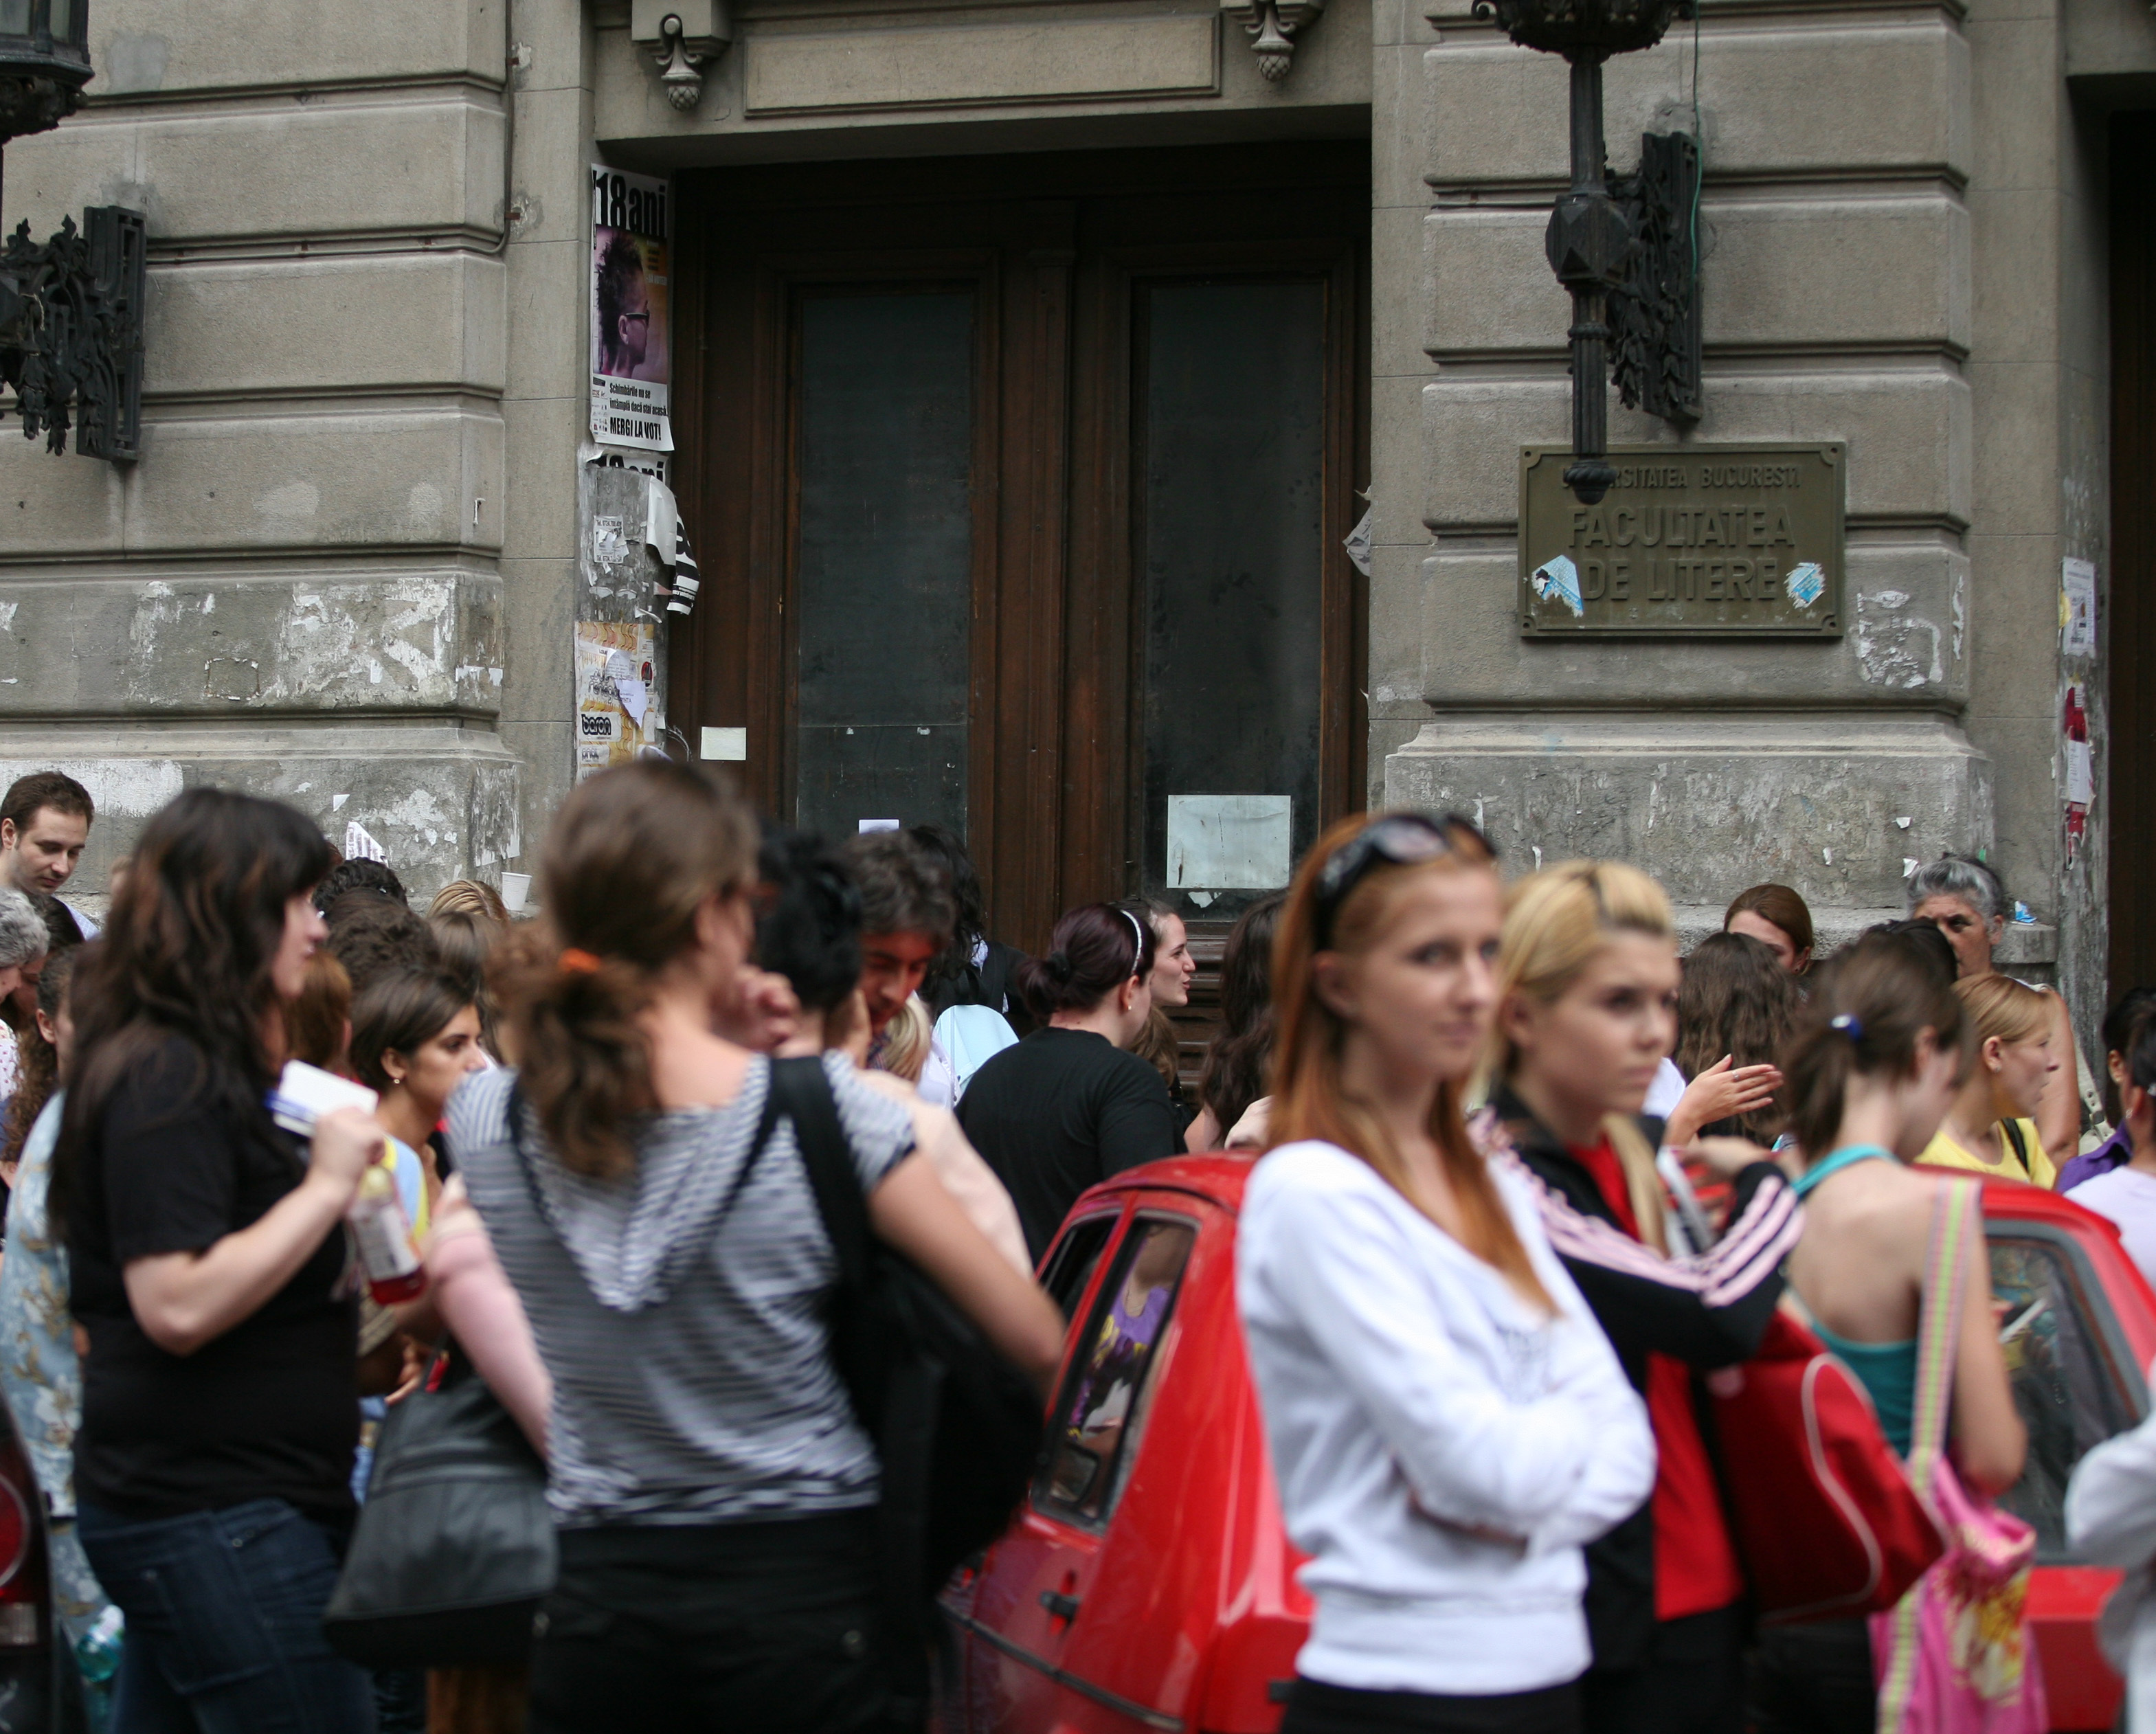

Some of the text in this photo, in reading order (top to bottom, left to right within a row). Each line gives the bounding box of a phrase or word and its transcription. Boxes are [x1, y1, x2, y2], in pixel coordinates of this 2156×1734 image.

[610, 417, 661, 440] MERGI LA VOT!
[1562, 466, 1687, 488] RSITATEA
[1568, 505, 1795, 548] FACULTATEA
[1582, 558, 1630, 600] DE
[1647, 558, 1778, 600] LITERE
[581, 714, 612, 736] baron
